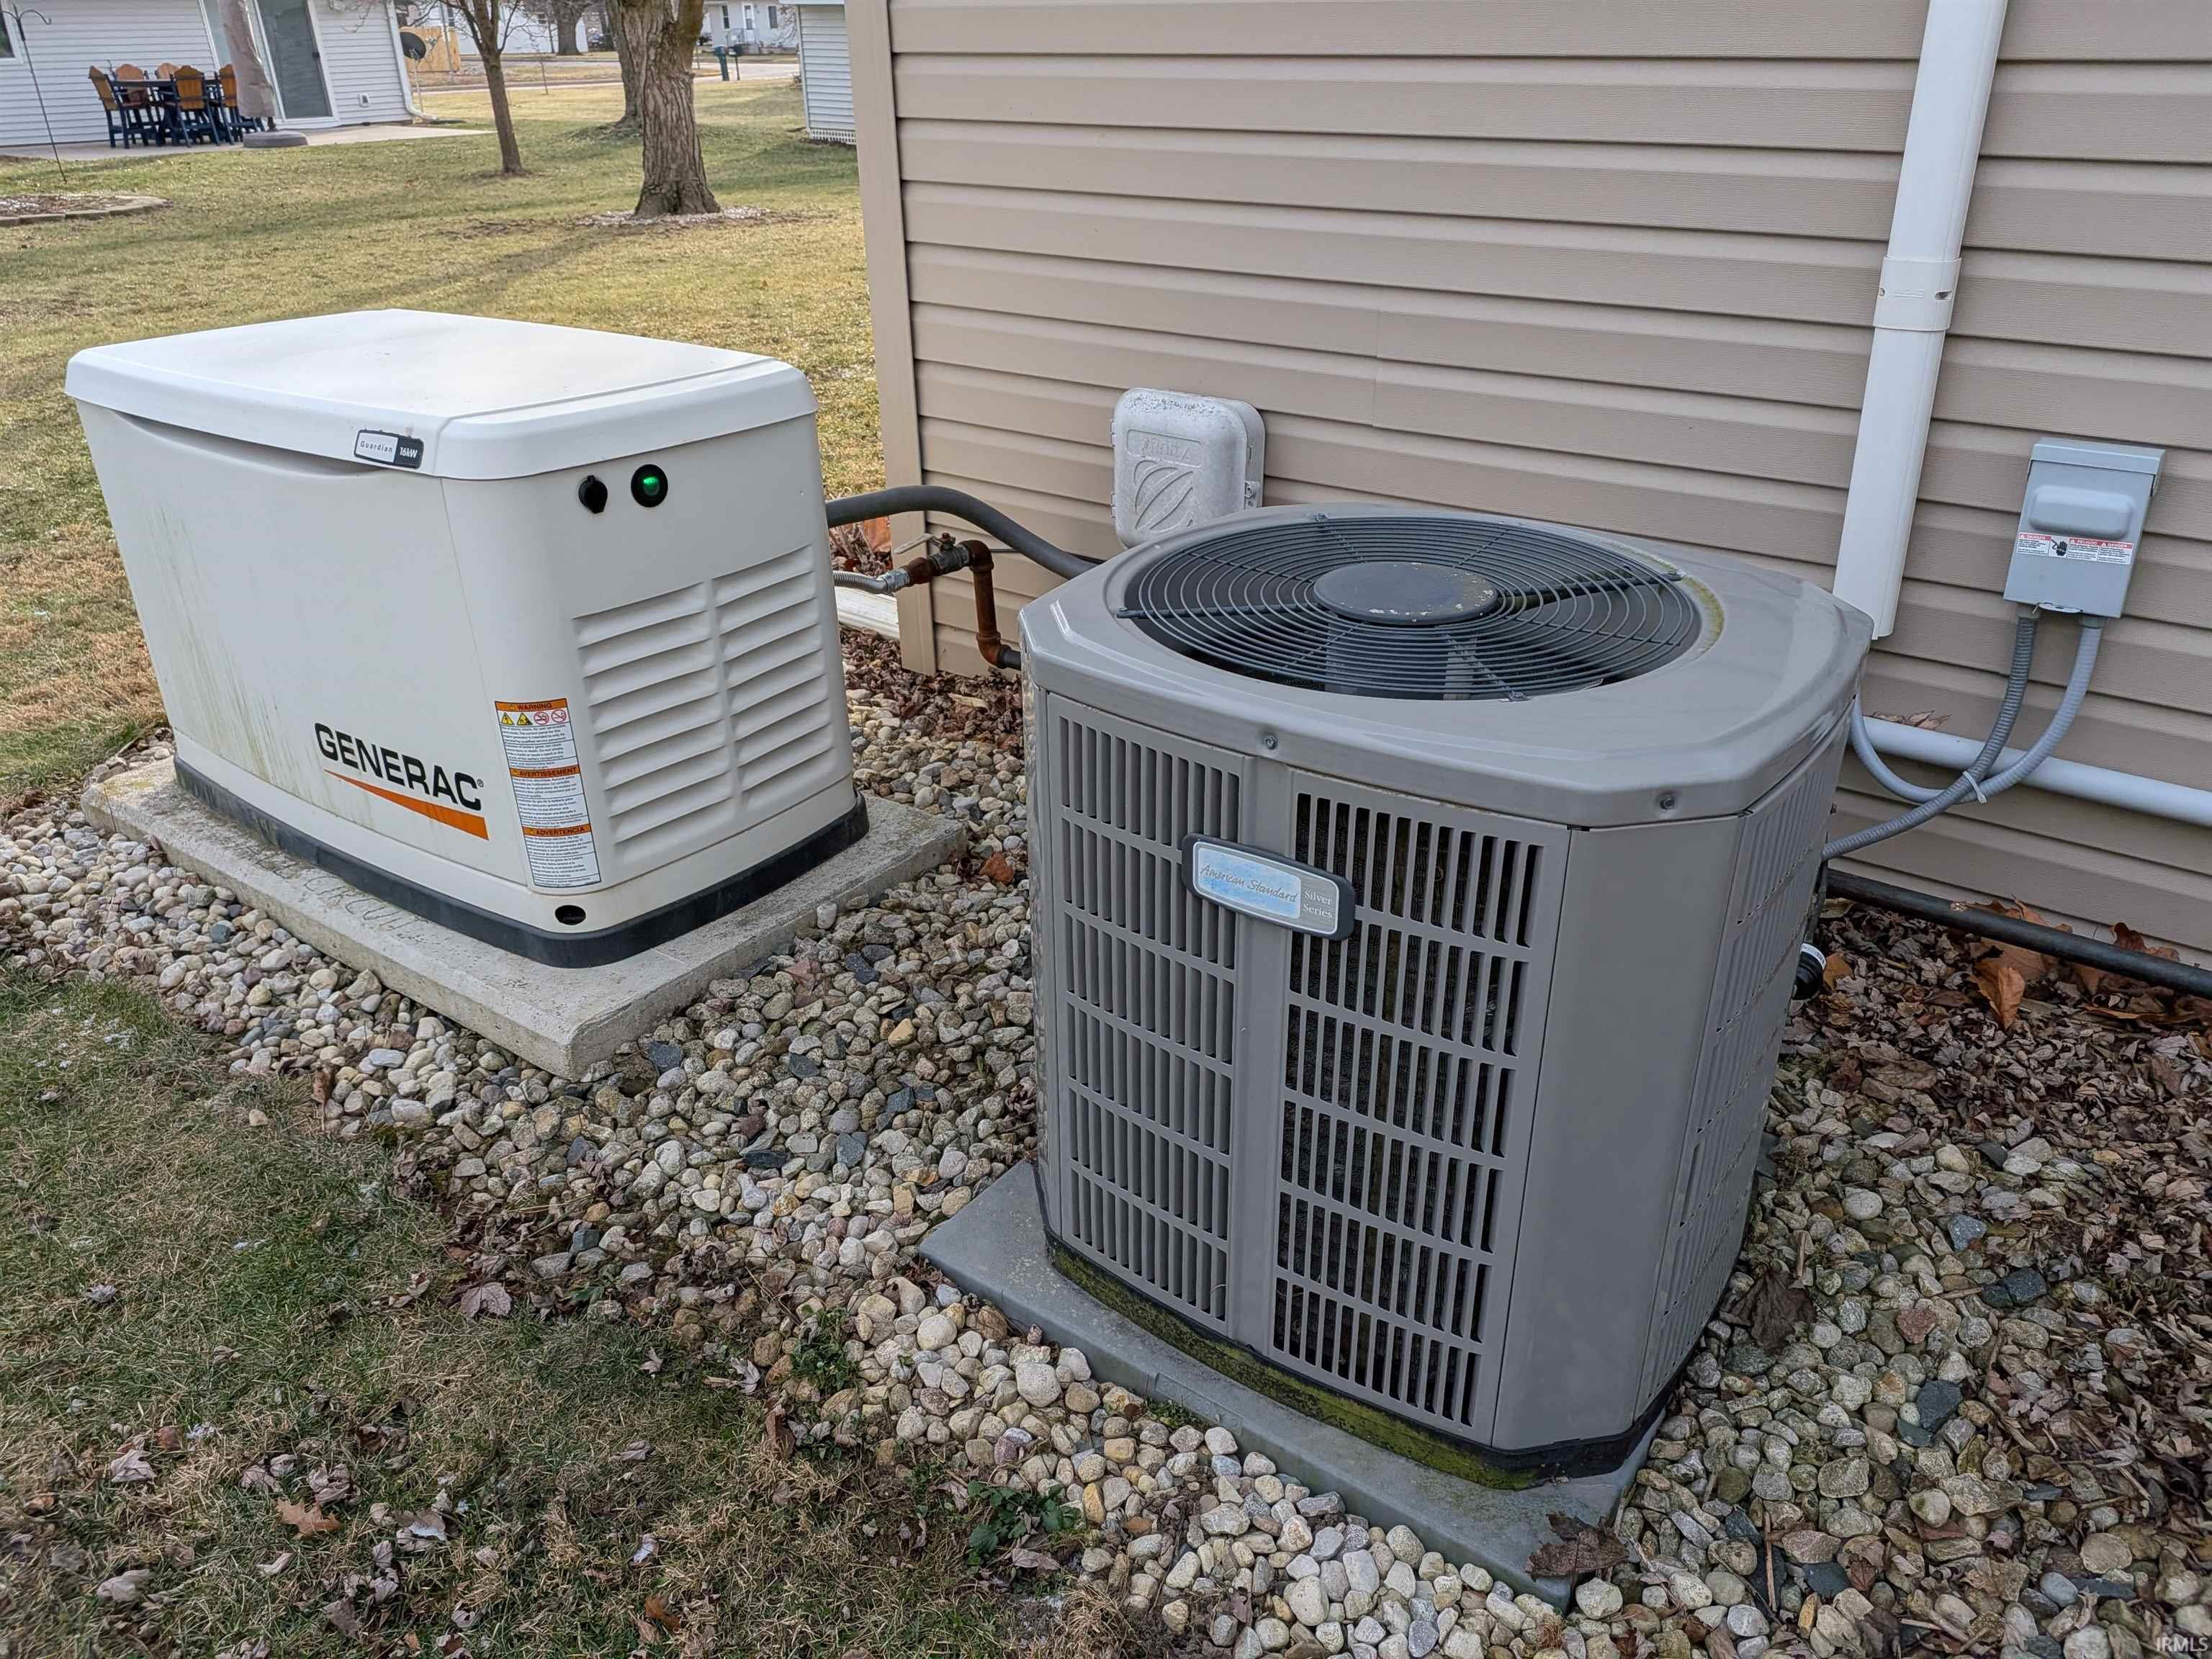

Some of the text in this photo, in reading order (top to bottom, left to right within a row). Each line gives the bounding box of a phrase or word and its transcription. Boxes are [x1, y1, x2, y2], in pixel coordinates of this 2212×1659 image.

[360, 441, 392, 452] Guardian
[314, 722, 482, 811] GENERAC
[518, 767, 577, 776] AVERTISSEMENT
[1200, 864, 1299, 902] American Standard
[1303, 890, 1333, 905] Silver
[1303, 904, 1333, 919] Series
